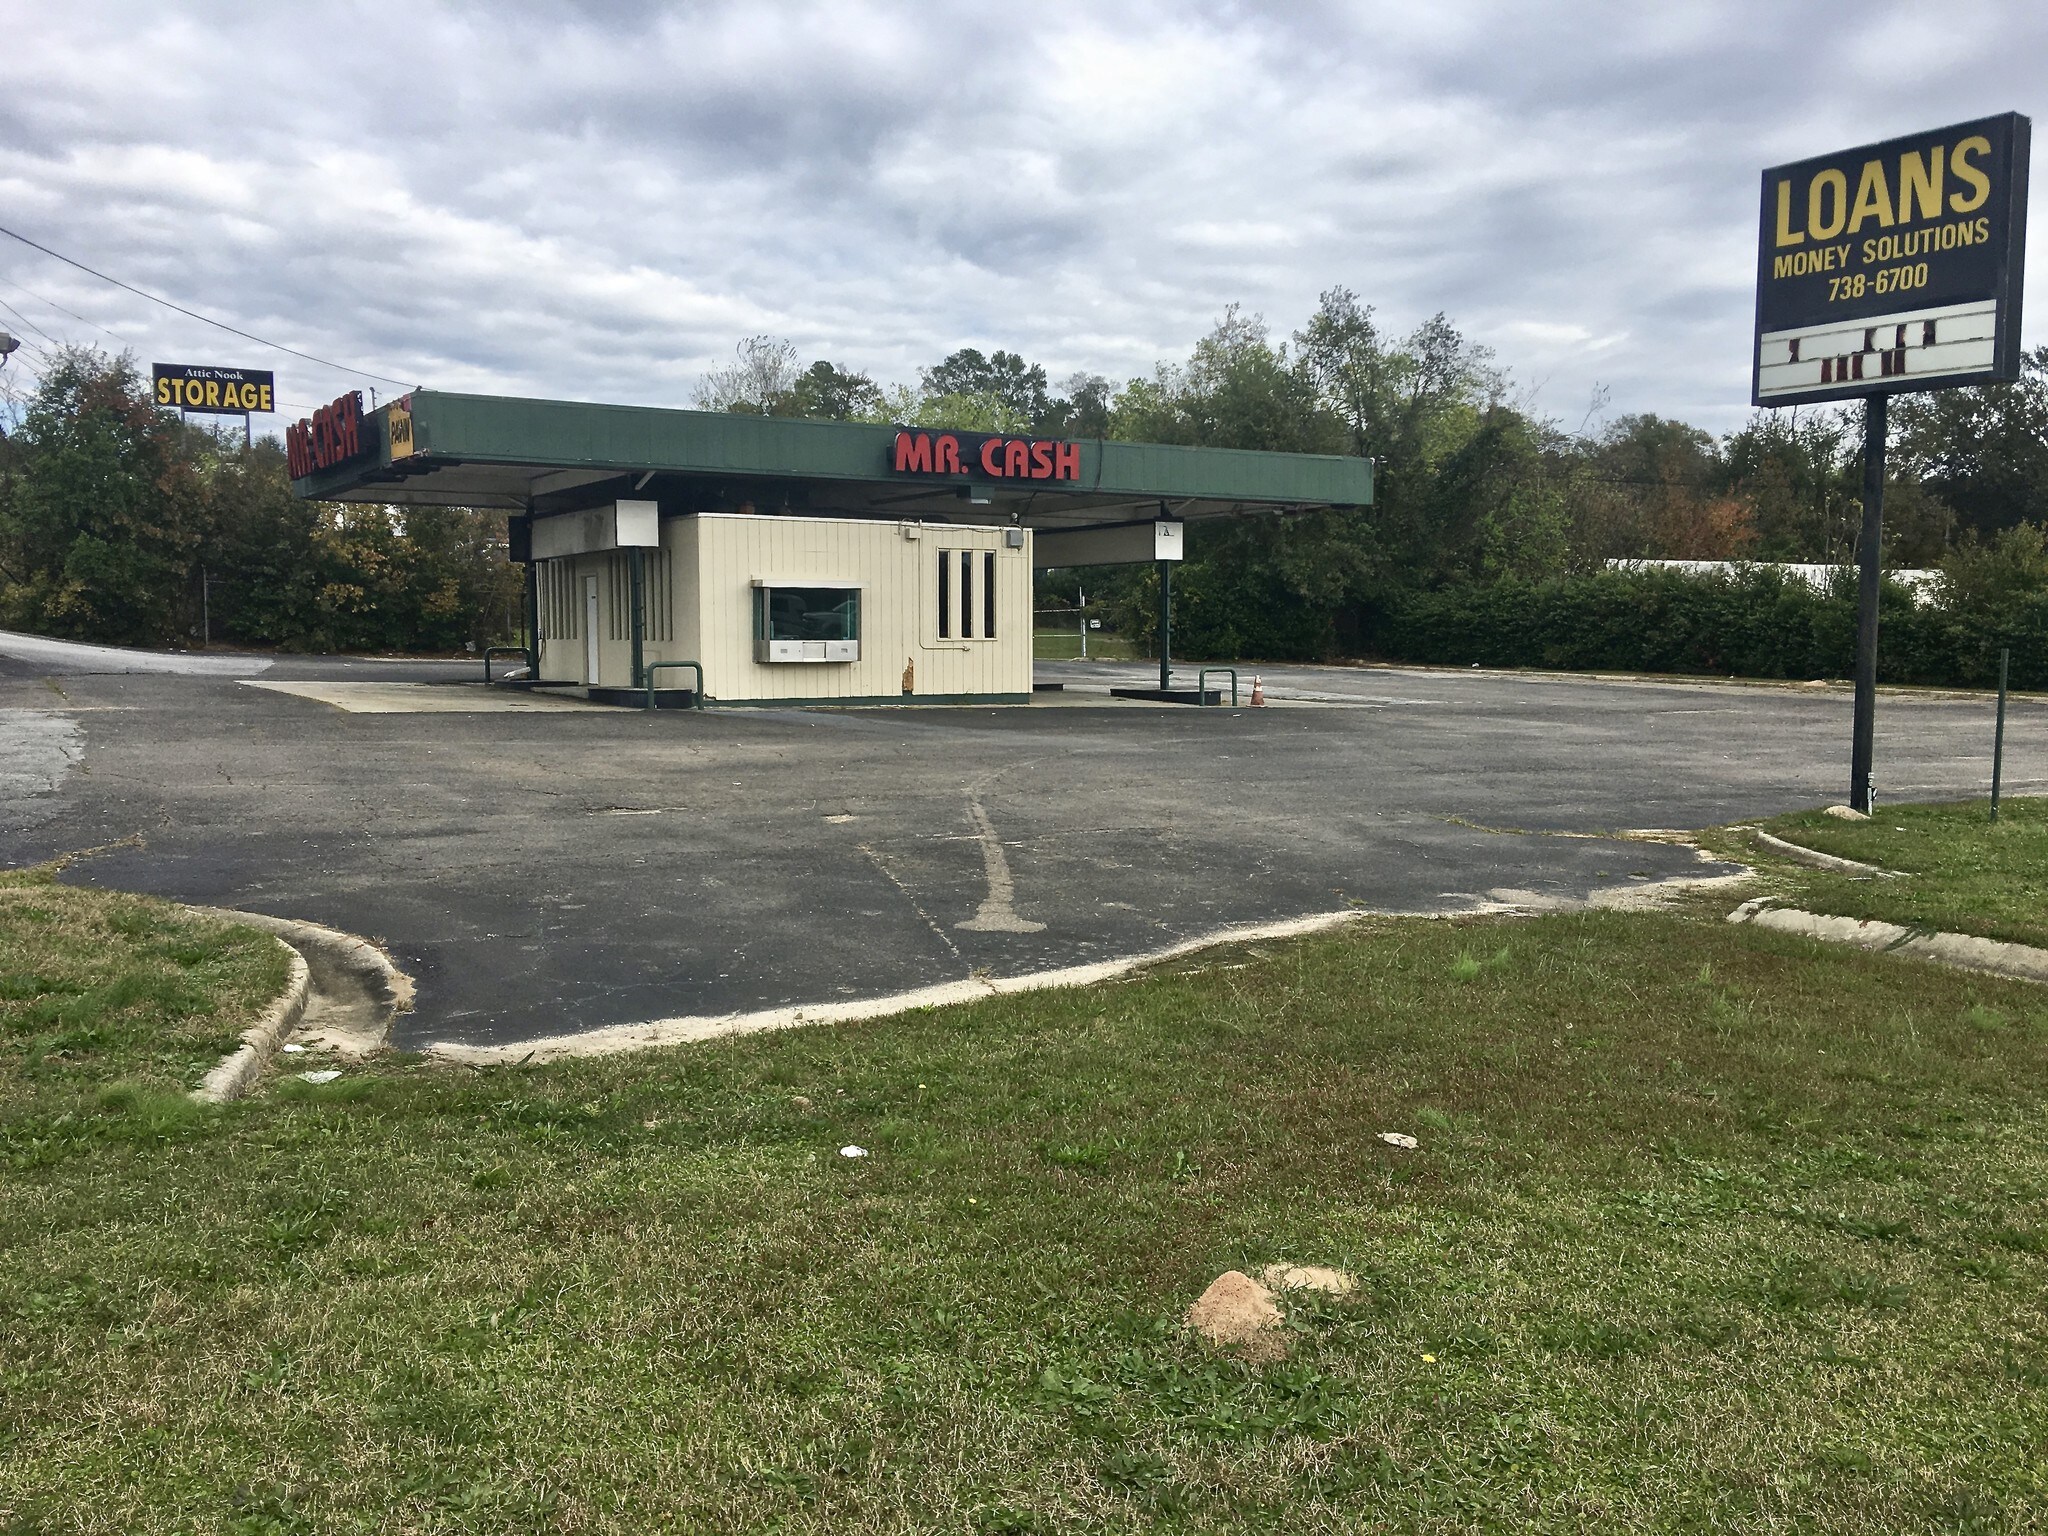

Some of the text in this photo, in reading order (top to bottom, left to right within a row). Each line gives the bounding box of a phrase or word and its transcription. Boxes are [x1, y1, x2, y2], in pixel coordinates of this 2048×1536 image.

[1776, 135, 1992, 248] LOANS
[1774, 217, 1990, 279] MONEY SOLUTIONS
[1828, 262, 1929, 302] 738-6700
[157, 377, 272, 410] STORAGE
[185, 368, 244, 380] Attic Nook
[312, 390, 359, 469] CASH
[895, 432, 1080, 480] MR. CASH
